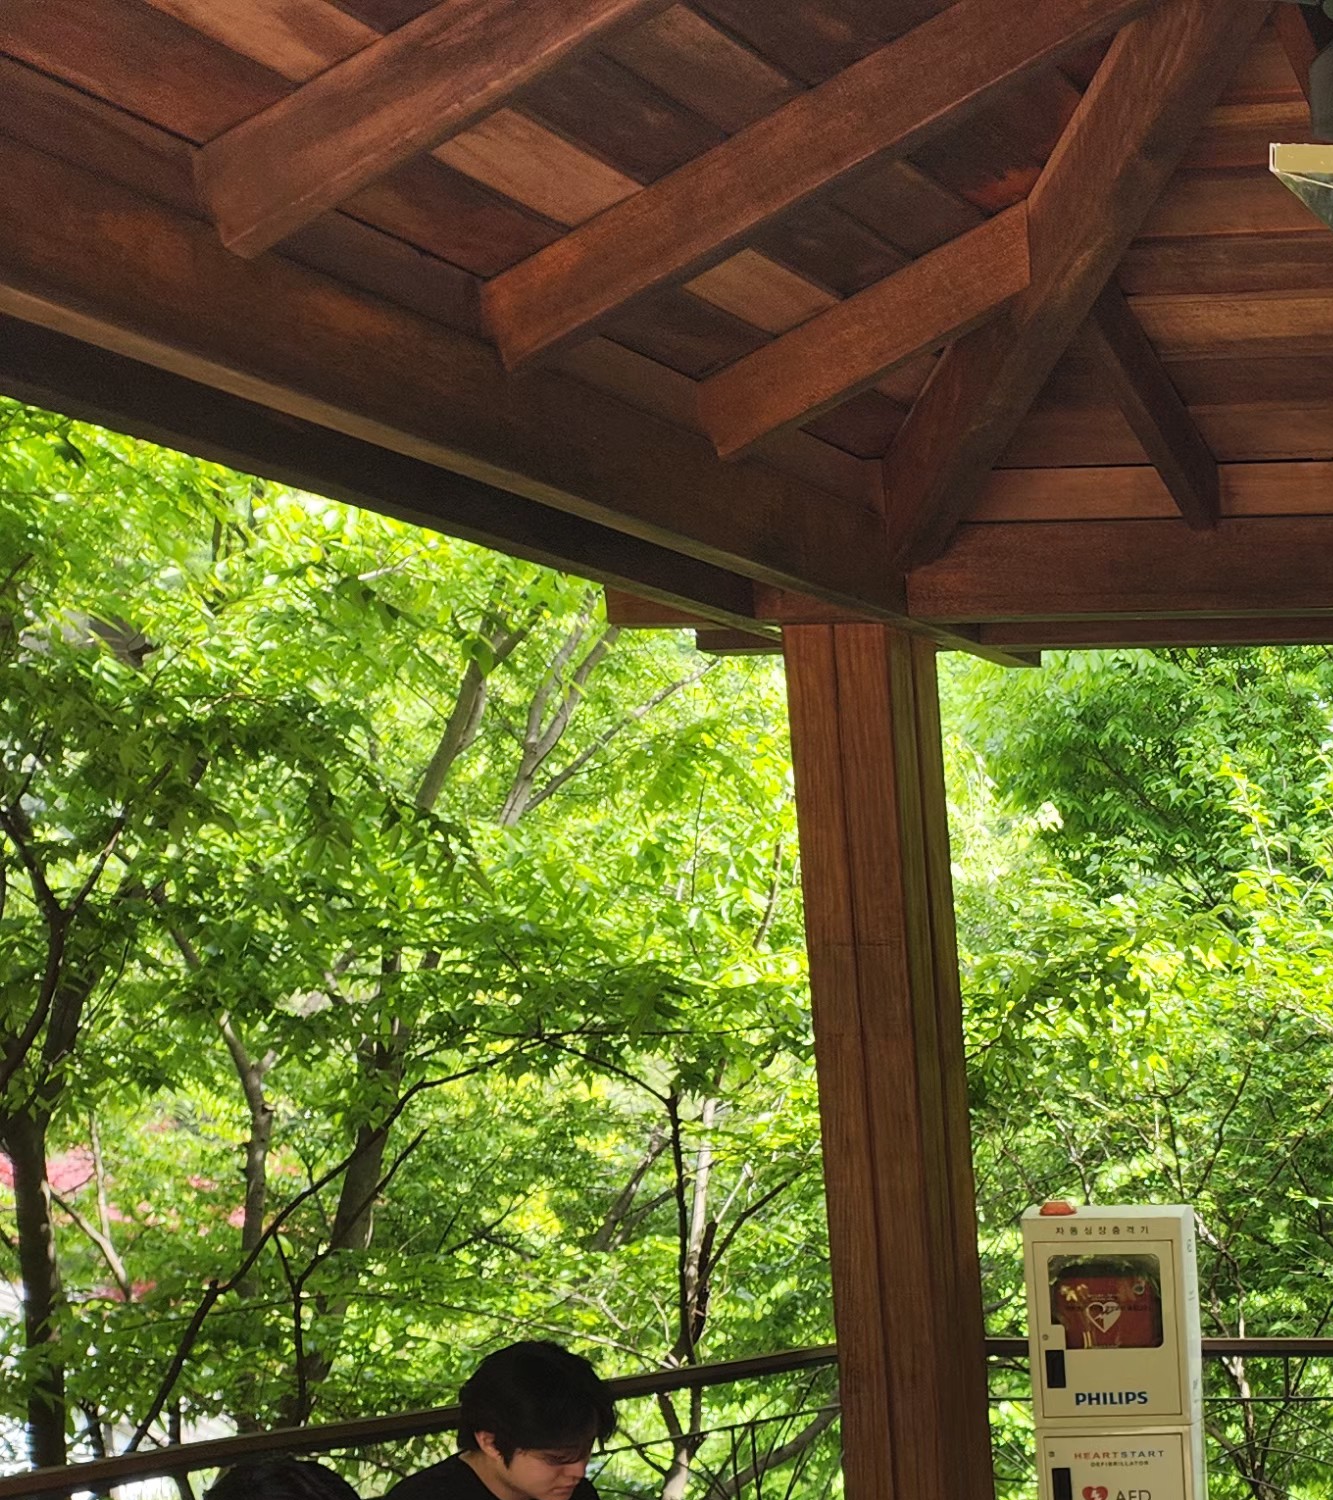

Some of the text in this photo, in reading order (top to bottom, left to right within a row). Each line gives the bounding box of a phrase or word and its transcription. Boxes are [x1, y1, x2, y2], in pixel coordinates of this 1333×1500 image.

[1055, 1225, 1150, 1236] 자동심장충격기
[1075, 1391, 1149, 1406] PHILIPS
[1074, 1450, 1165, 1459] HEARTSTART
